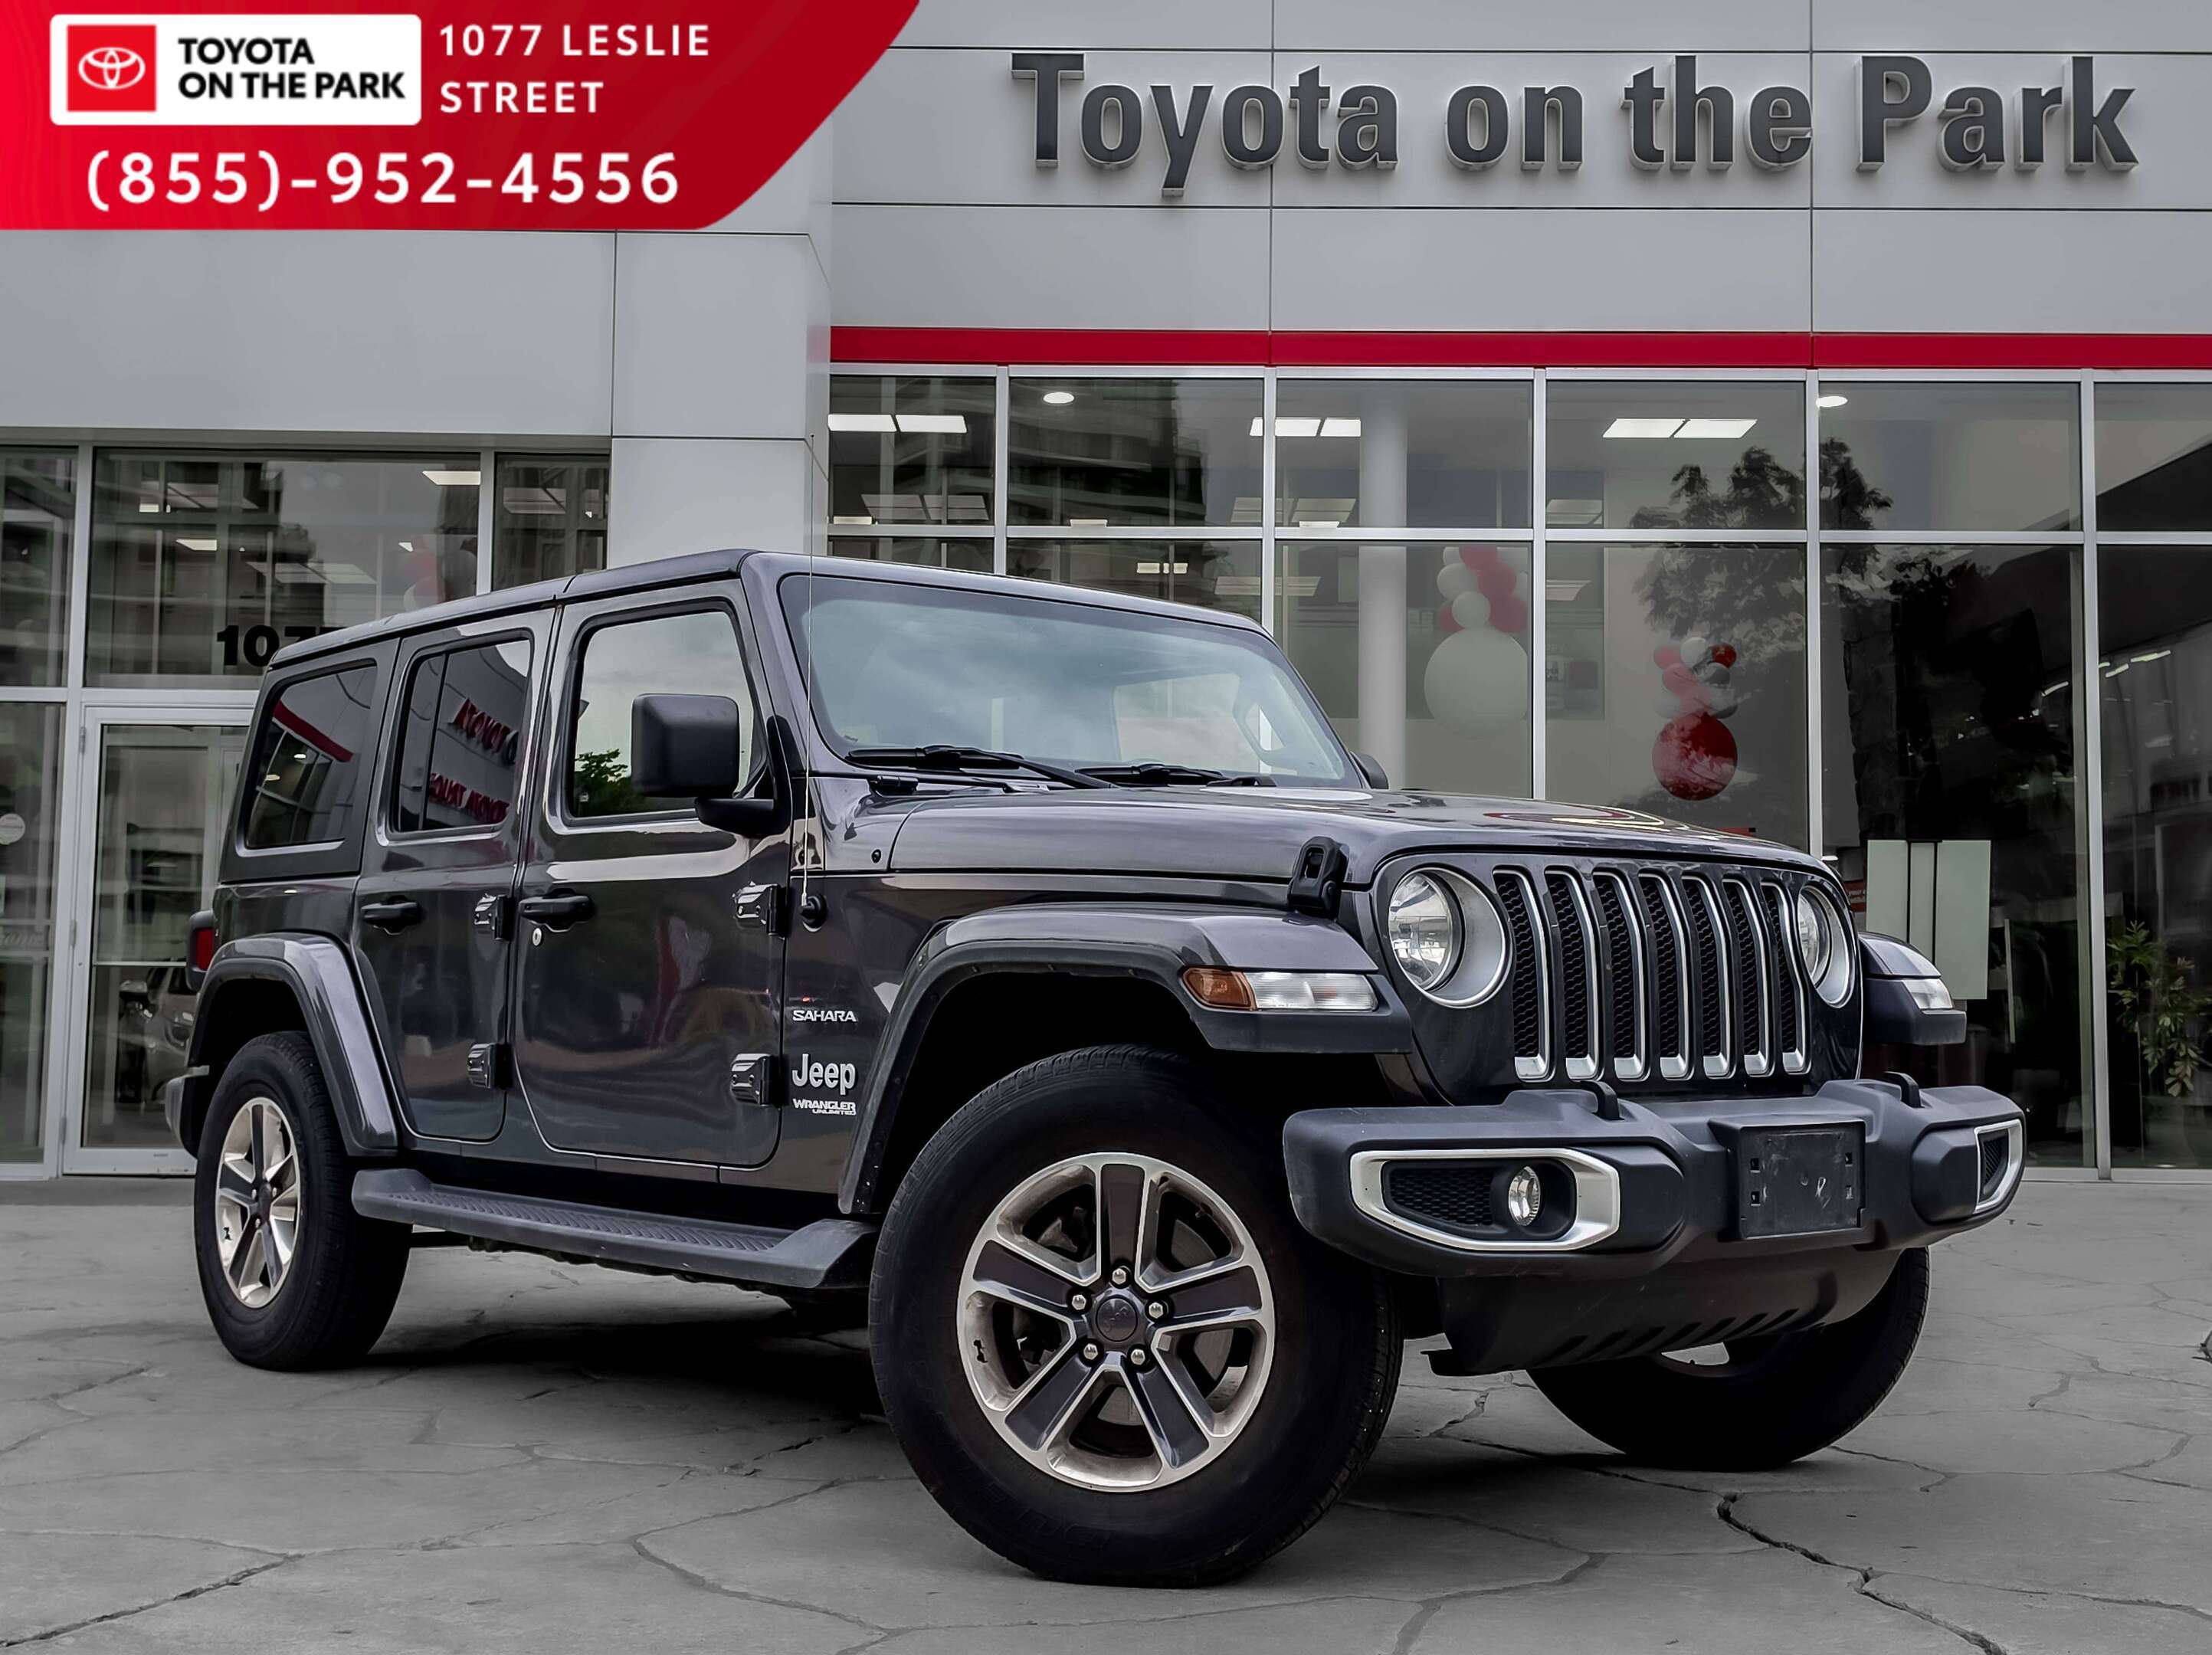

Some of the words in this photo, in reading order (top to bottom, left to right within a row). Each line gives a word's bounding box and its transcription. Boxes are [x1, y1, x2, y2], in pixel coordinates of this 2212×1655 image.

[1011, 52, 1398, 197] Toyota
[1445, 84, 1583, 171] on
[1620, 55, 1813, 172] the
[1856, 55, 2139, 172] Park
[217, 624, 348, 667] 107
[791, 1009, 857, 1023] SAHARA
[791, 1053, 856, 1096] Jeep
[792, 1098, 856, 1110] WRANGLER
